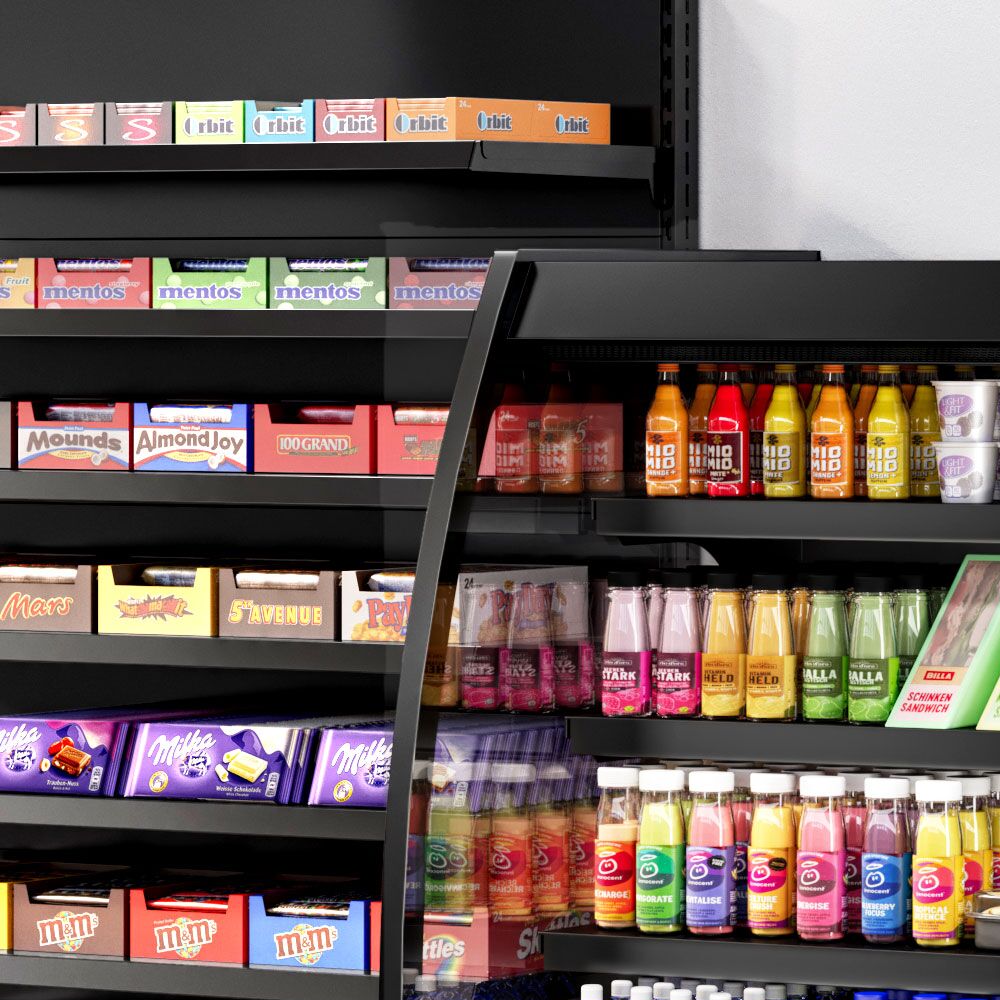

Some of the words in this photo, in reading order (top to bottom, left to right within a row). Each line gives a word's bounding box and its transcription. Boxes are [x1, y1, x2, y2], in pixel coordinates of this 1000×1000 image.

[184, 117, 235, 136] Orbit
[253, 116, 306, 135] Orbit
[323, 113, 377, 135] Orbit
[394, 112, 448, 134] Orbit
[476, 111, 512, 131] Orbit
[554, 113, 589, 134] Orbit
[6, 277, 30, 285] Fruit
[43, 284, 125, 299] mentos
[159, 284, 242, 299] mentos
[275, 284, 361, 299] mentos
[395, 284, 481, 300] mentos
[942, 397, 964, 406] LIGHT
[26, 431, 122, 453] Mounds
[136, 430, 210, 454] Almond
[213, 430, 244, 454] Joy
[279, 438, 301, 450] 100
[301, 438, 349, 451] GRAND
[942, 459, 964, 468] LIGHT
[0, 592, 73, 621] Mars
[249, 605, 322, 625] AVENUE
[602, 671, 636, 681] STARK
[657, 672, 690, 681] STARK
[704, 674, 734, 683] HELD
[749, 676, 779, 685] HELD
[926, 672, 953, 680] BILLA
[907, 692, 953, 702] SCHINKEN
[900, 703, 949, 713] SANDWICH
[148, 729, 216, 766] Milka
